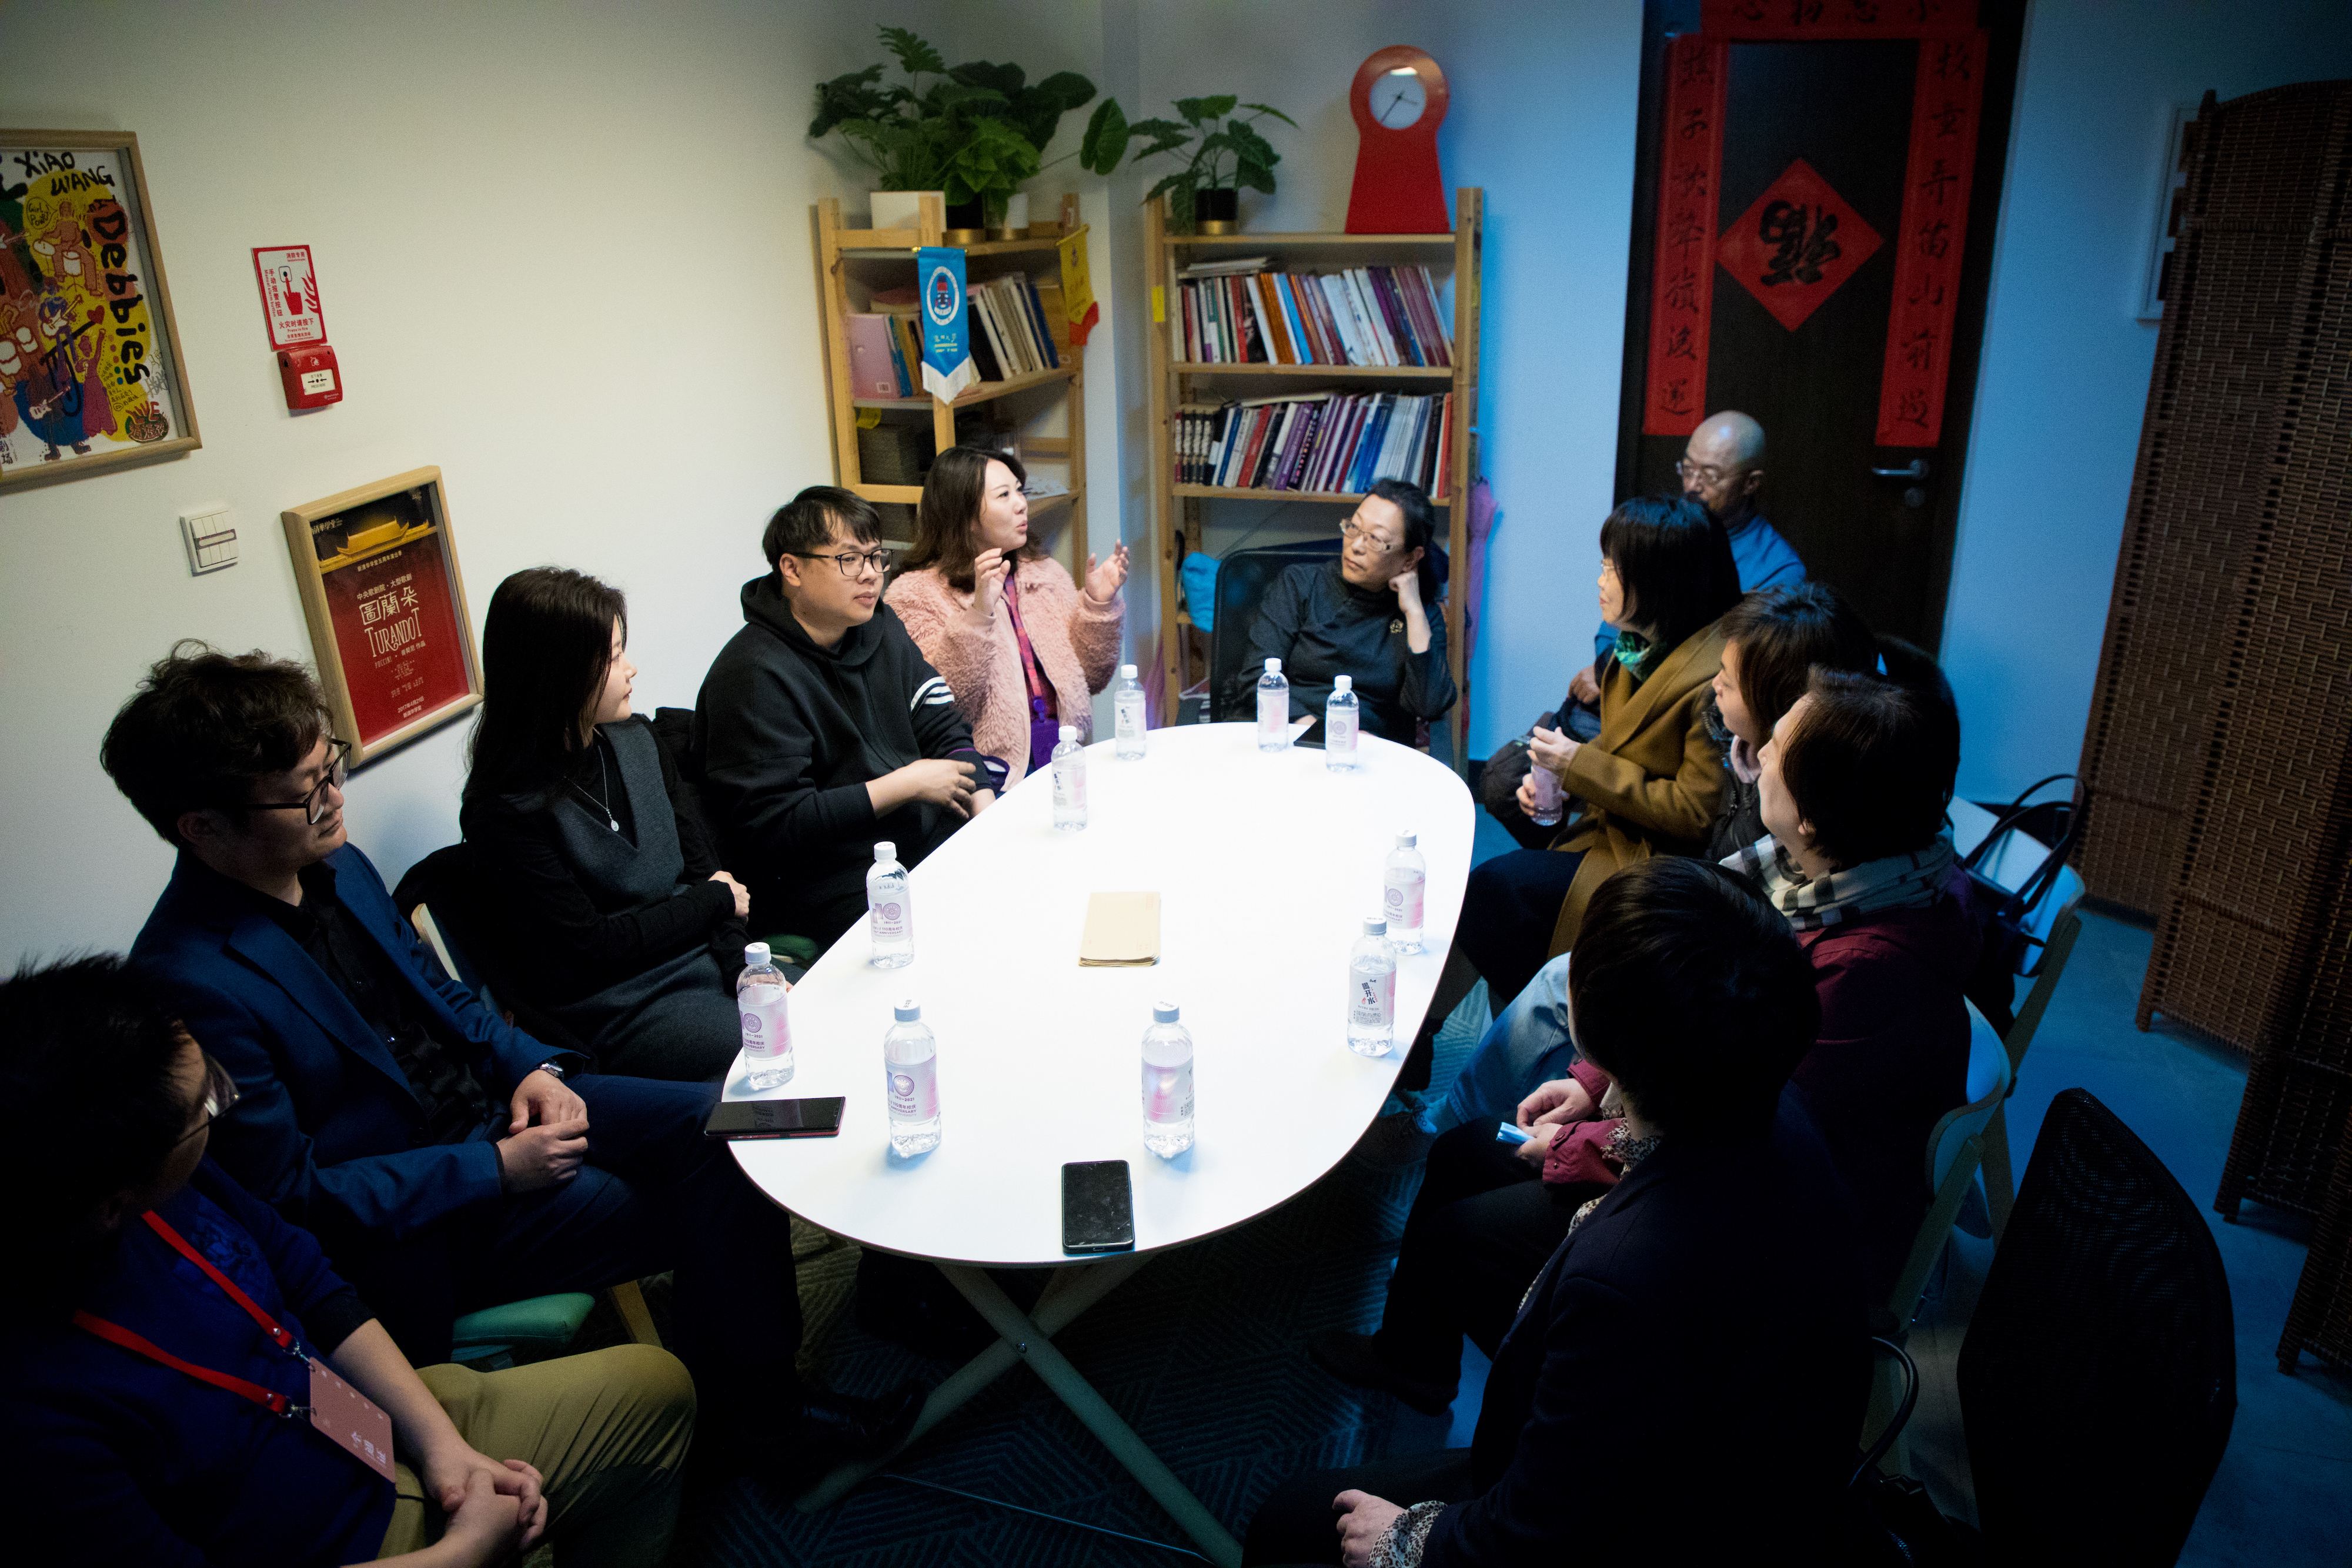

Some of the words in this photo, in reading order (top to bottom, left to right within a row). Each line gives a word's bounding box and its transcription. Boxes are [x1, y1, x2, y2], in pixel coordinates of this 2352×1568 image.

[51, 165, 115, 196] WANG
[93, 210, 150, 385] Debbies
[279, 318, 314, 329] 火灾时请按下
[126, 400, 160, 425] LIVE
[359, 586, 418, 626] 圖蘭朵
[365, 607, 422, 657] TURANDOT
